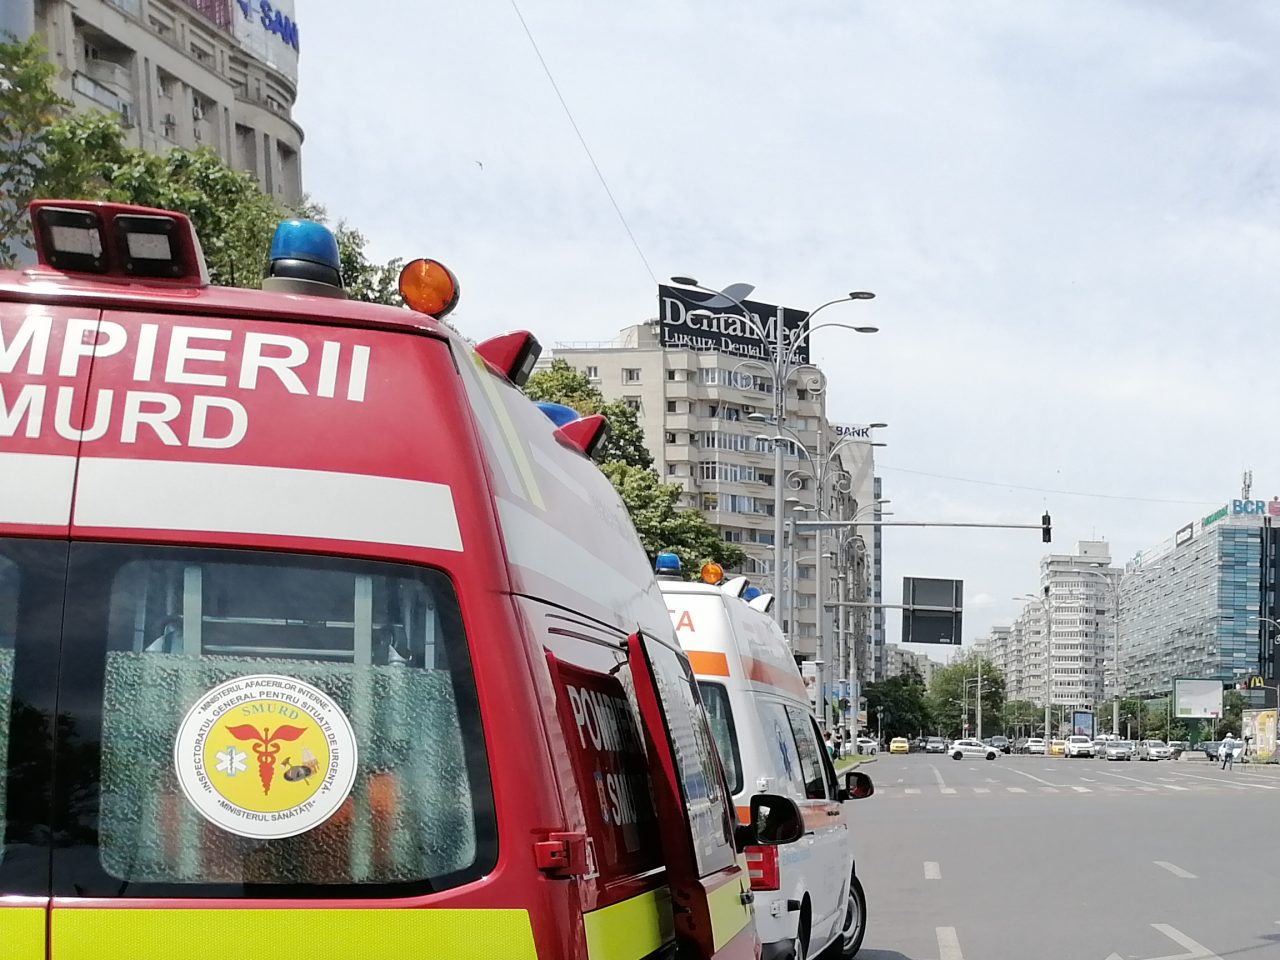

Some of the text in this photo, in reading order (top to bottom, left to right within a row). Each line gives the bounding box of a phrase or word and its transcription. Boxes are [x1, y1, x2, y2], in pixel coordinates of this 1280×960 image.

[663, 297, 807, 347] DentalMed
[664, 327, 716, 347] Luxury
[721, 337, 764, 358] Dental
[836, 426, 869, 438] BANK
[1233, 499, 1265, 514] BCR
[201, 680, 329, 712] MINISTERUL AFACERILOR INTERNE
[241, 703, 299, 720] SMURD
[194, 716, 214, 792] INSPECTORATUL
[213, 692, 256, 717] GENERAL
[259, 690, 300, 704] PENTRU
[329, 732, 338, 747] DE
[219, 801, 269, 822] MINISTERUL
